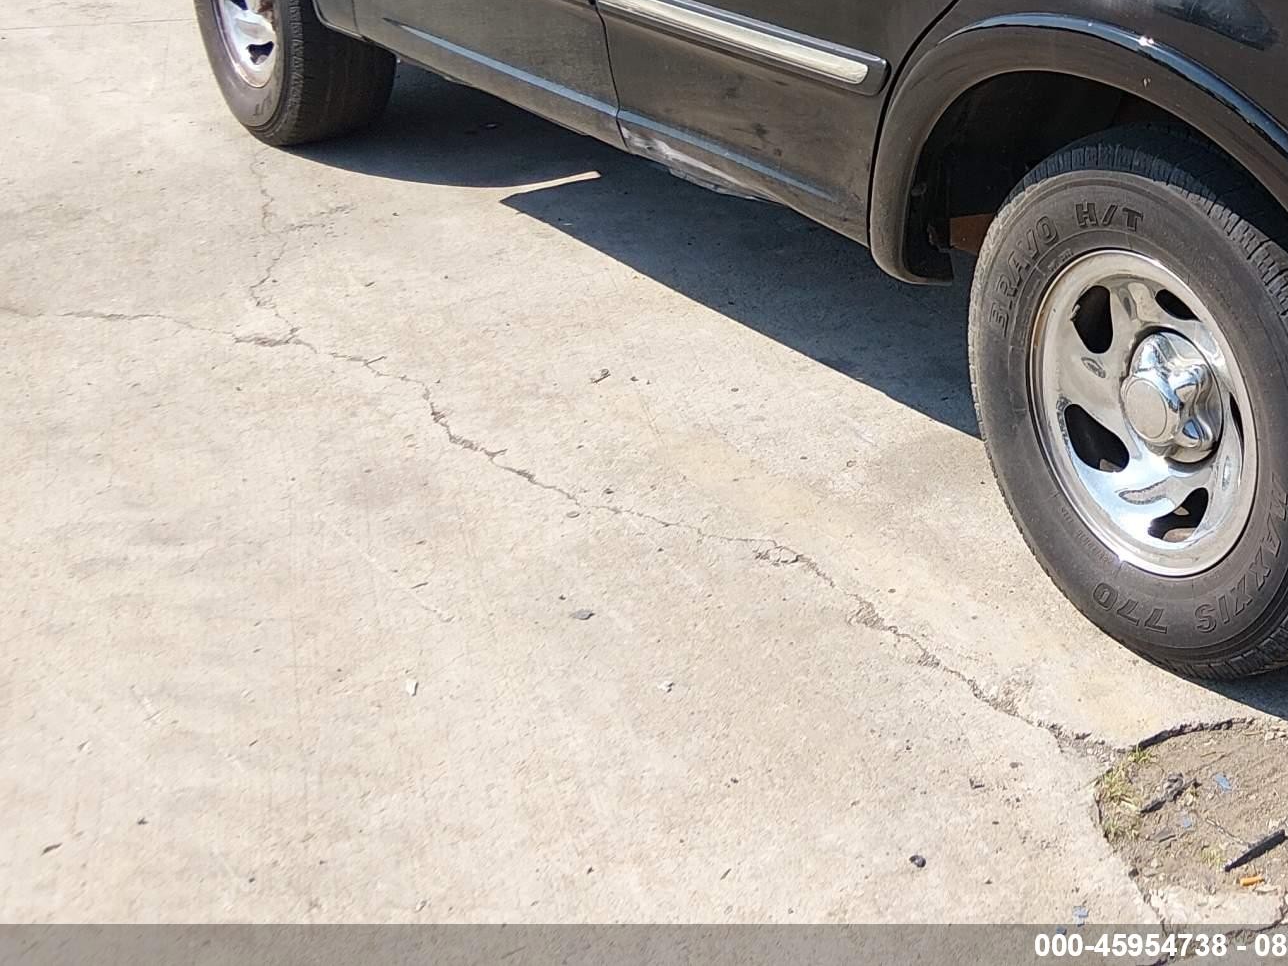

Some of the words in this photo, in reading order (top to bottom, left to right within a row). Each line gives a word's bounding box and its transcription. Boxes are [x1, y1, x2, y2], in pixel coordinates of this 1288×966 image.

[989, 216, 1058, 336] BRAVO
[1074, 201, 1145, 233] H/T
[1091, 581, 1169, 635] 770
